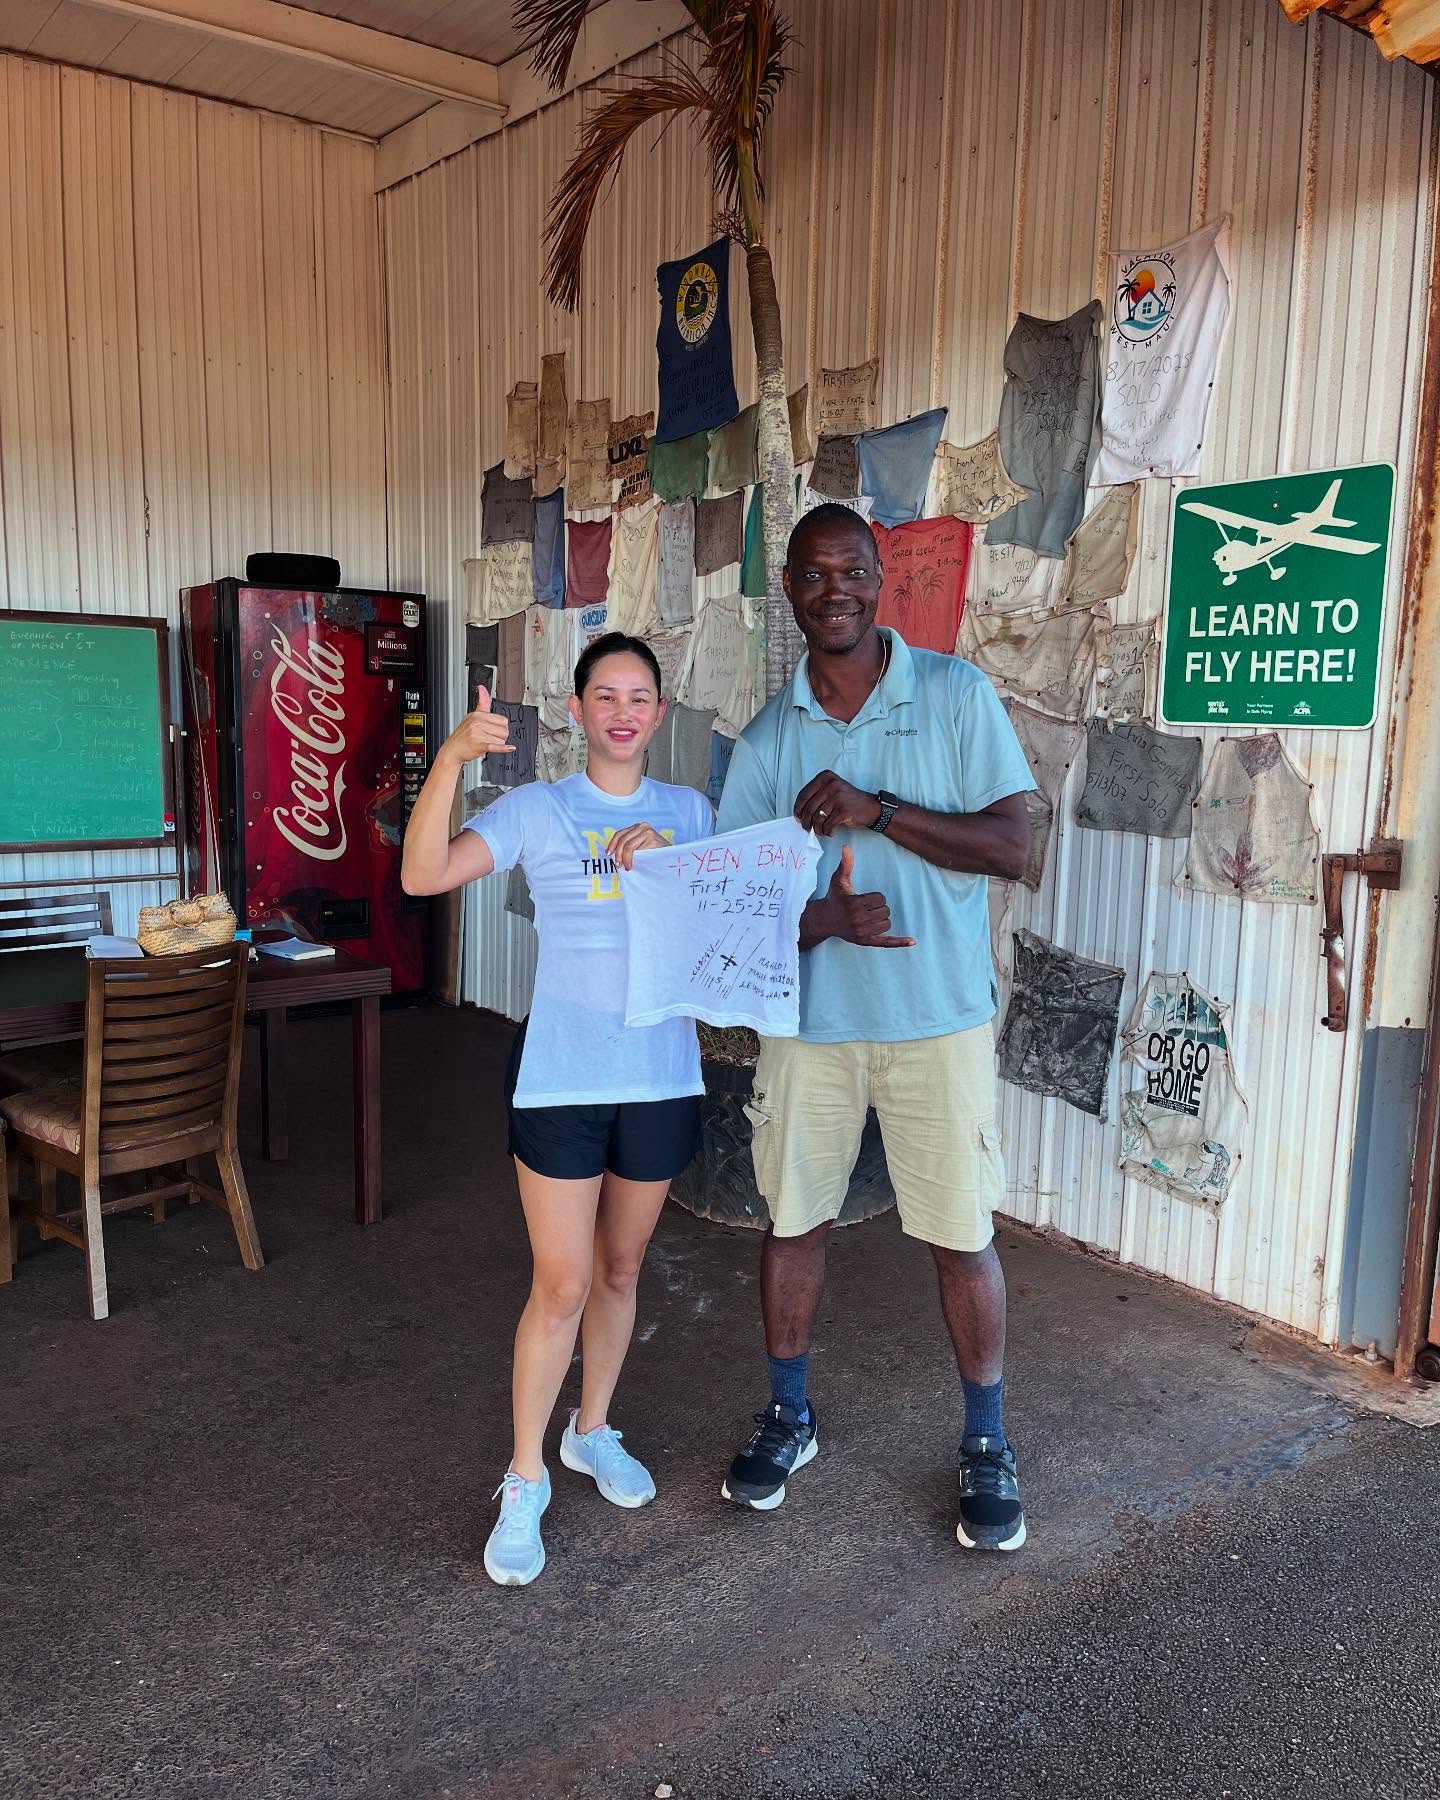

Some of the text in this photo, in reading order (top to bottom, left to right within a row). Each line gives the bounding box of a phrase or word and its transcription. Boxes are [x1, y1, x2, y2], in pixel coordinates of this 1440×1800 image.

[1121, 251, 1176, 275] VACATION
[1110, 315, 1175, 350] WEST MAUI
[823, 373, 848, 389] FIRST
[1116, 382, 1161, 408] SOLO
[1189, 598, 1359, 637] LEARN TO
[377, 640, 407, 650] Millions
[1105, 632, 1144, 647] DYLAN
[1186, 649, 1356, 683] FLY HERE!
[270, 622, 348, 861] Coca-Cola
[1114, 724, 1148, 749] Chris
[1086, 770, 1127, 803] 5/13/07
[1108, 748, 1144, 786] First
[1138, 780, 1168, 820] Solo
[688, 876, 785, 900] First Solo
[697, 898, 781, 919] 11-25-25
[1147, 1032, 1210, 1074] OR GO
[1147, 1068, 1204, 1107] HOME
